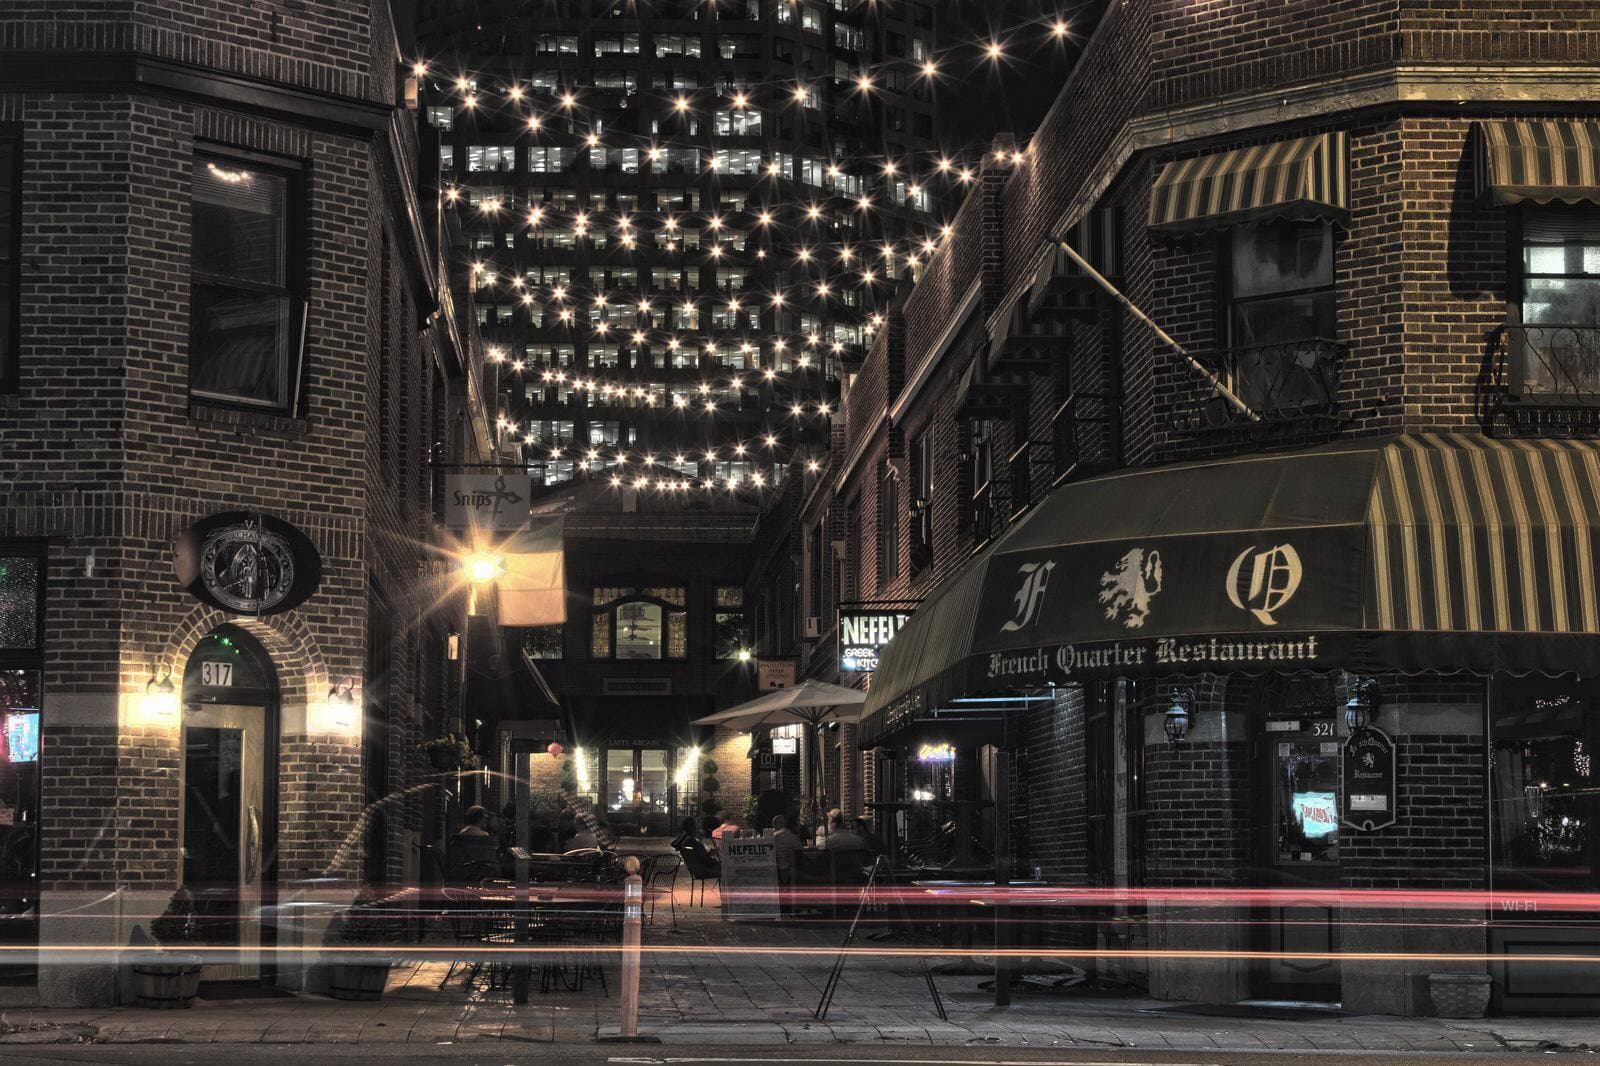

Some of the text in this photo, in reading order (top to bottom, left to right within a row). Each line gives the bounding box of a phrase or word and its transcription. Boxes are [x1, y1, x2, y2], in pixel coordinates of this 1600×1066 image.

[453, 490, 492, 511] Snips
[1226, 544, 1302, 625] Q
[844, 648, 875, 657] GREEK
[987, 635, 1319, 679] French Quarter Restaurant
[204, 663, 231, 685] 317
[1312, 722, 1334, 736] 321
[1500, 899, 1537, 912] WI-FI
